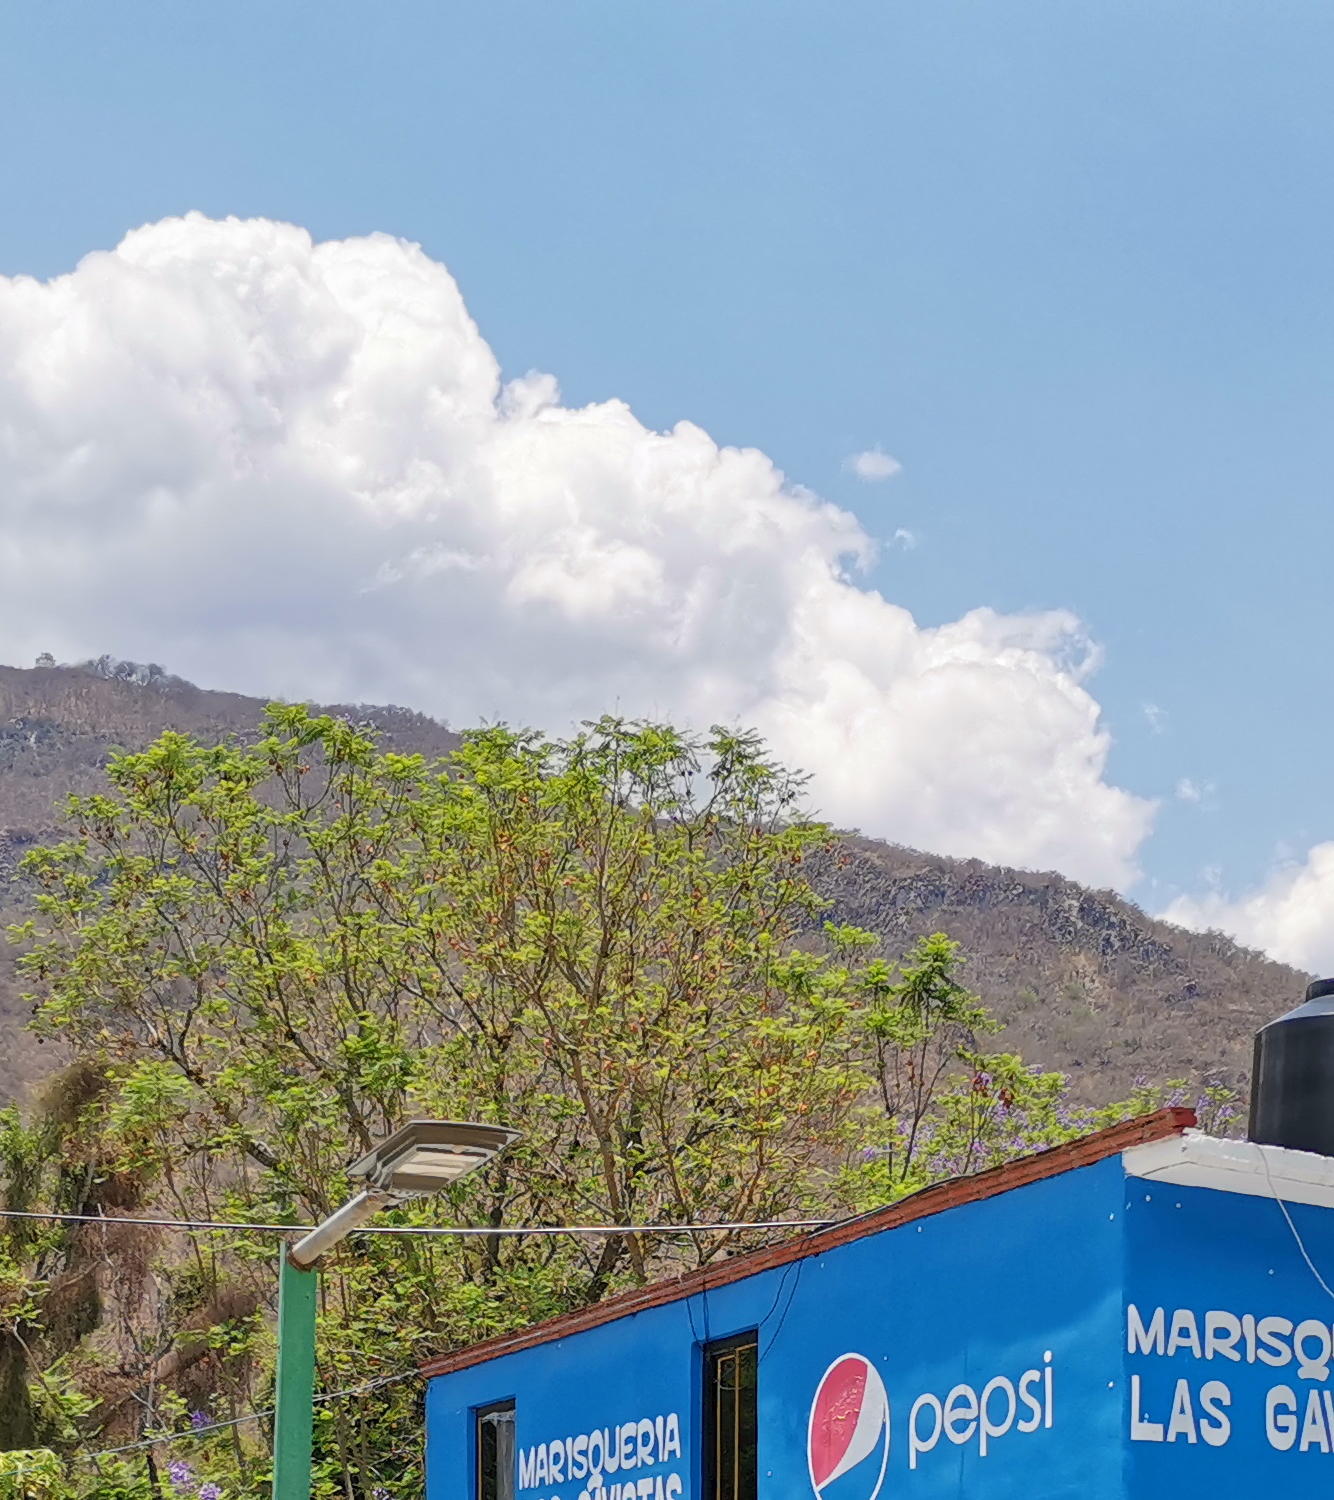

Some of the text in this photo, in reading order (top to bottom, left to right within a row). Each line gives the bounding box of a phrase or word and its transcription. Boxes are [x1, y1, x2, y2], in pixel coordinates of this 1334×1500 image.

[908, 1350, 1054, 1471] pepsi
[1130, 1375, 1231, 1447] LAS
[518, 1413, 681, 1493] MARISQUERIA
